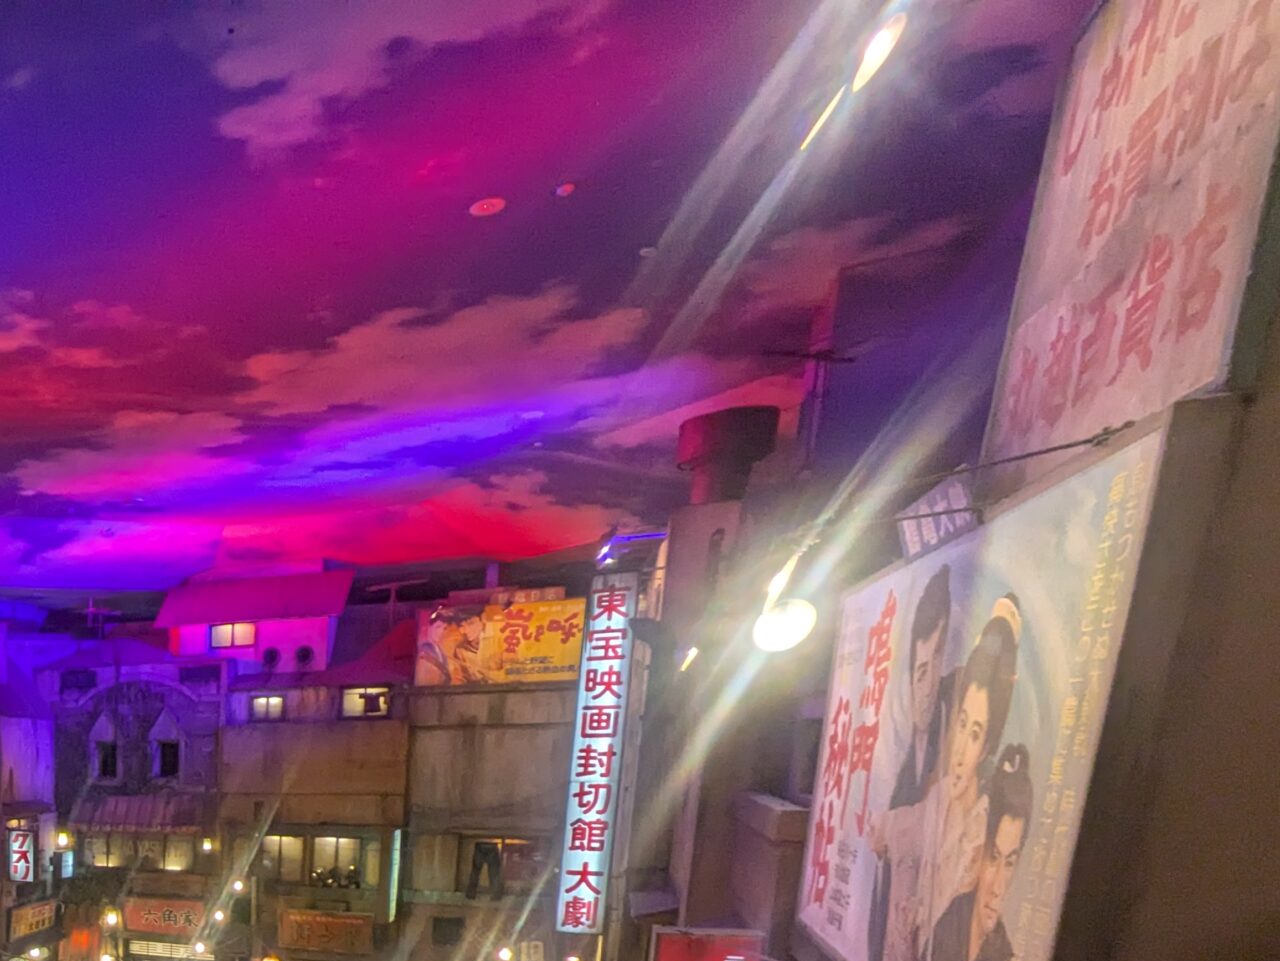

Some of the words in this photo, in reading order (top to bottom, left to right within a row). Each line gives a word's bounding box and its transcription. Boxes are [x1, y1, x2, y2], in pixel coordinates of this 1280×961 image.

[500, 608, 582, 653] 嵐を呼
[11, 832, 31, 880] クスリ
[143, 908, 198, 927] 六角家
